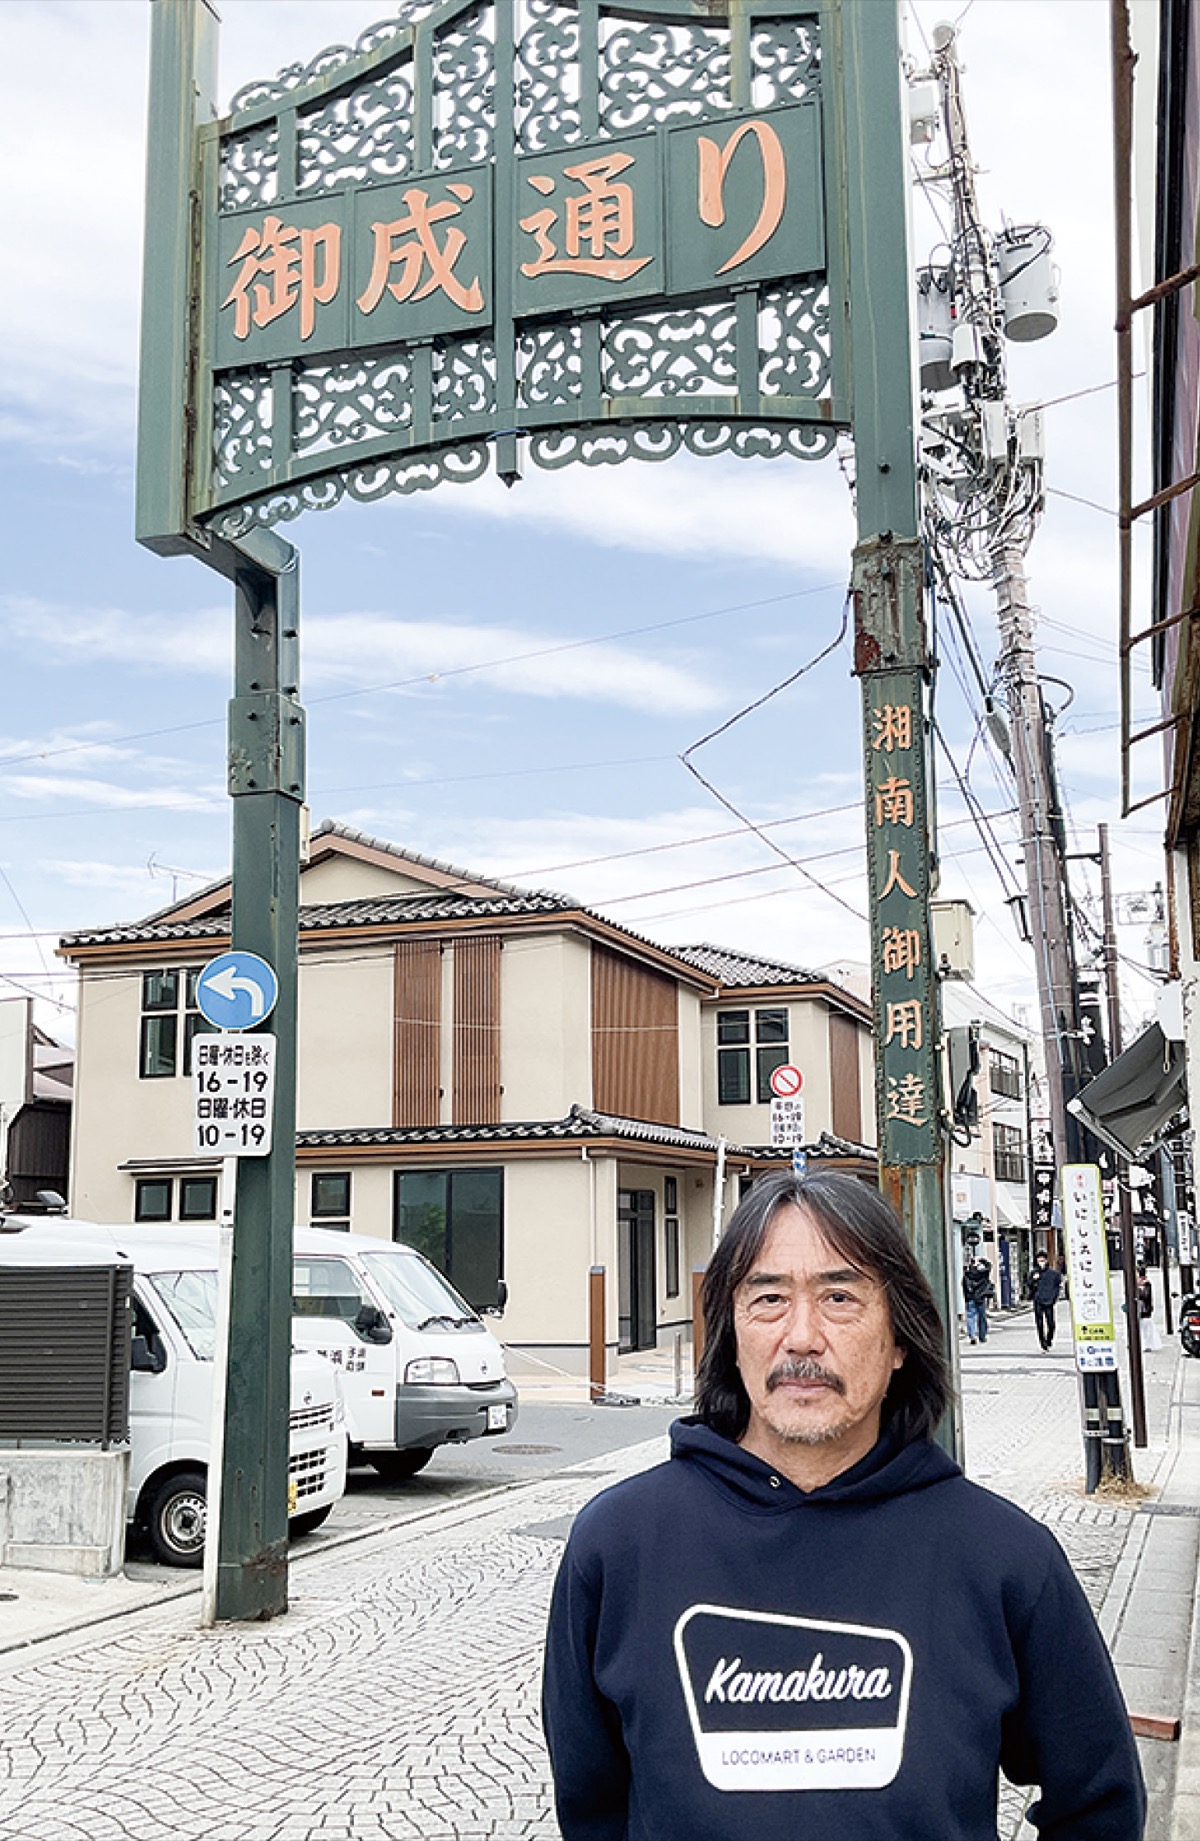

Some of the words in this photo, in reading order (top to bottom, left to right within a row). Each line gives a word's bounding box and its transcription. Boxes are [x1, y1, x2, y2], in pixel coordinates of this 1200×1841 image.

[219, 121, 787, 342] 御成通り
[871, 703, 928, 1126] 湘南人御用達
[198, 1071, 268, 1093] 16-19
[198, 1123, 265, 1147] 10-19
[704, 1652, 892, 1704] Kamakura
[722, 1750, 801, 1766] LOCOMART
[804, 1749, 814, 1764] &
[817, 1747, 876, 1764] GARDEN
